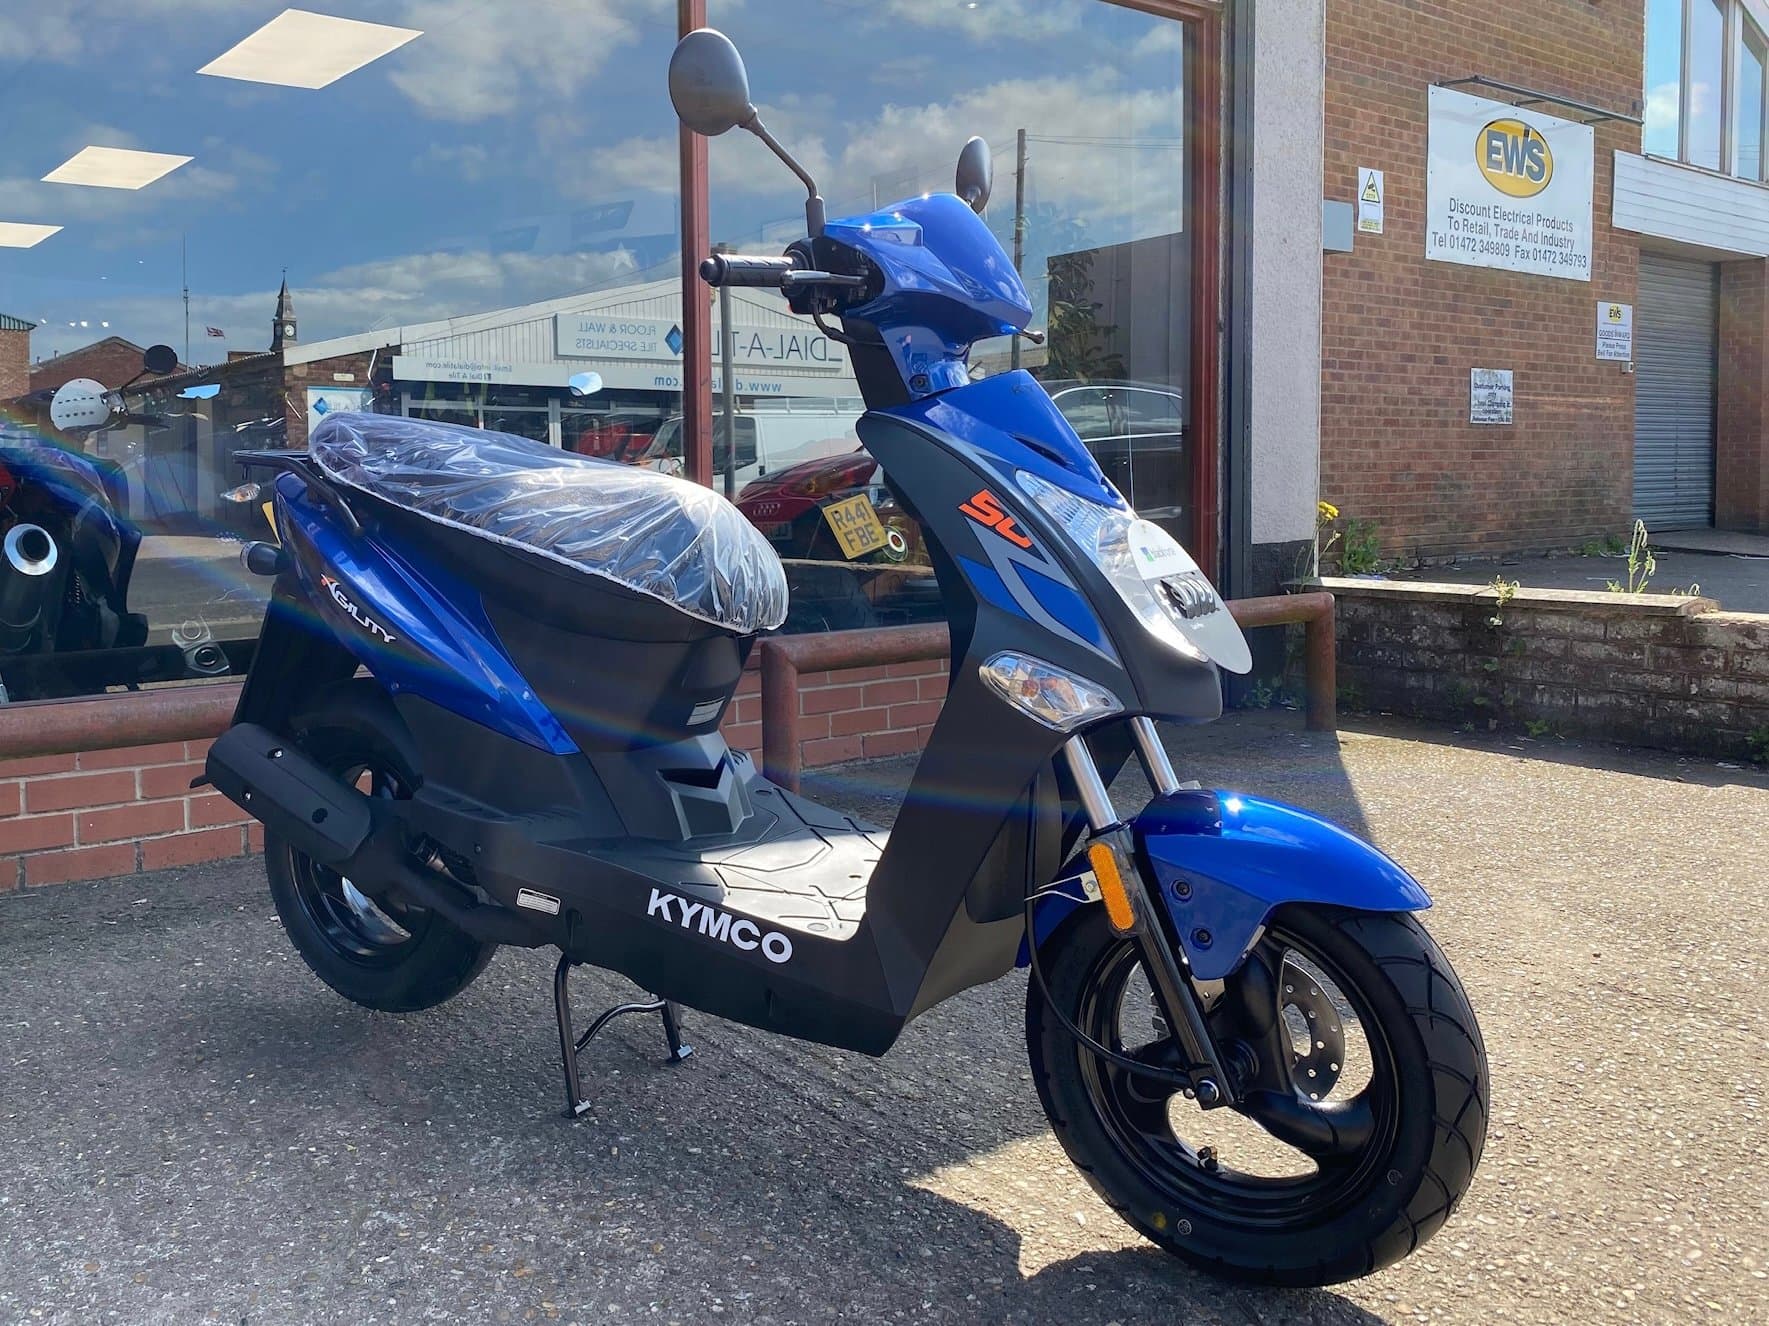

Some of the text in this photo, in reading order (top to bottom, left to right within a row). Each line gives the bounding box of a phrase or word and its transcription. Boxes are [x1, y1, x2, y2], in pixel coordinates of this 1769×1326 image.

[1449, 197, 1574, 233] Discount Electrical Products
[1432, 231, 1588, 269] Tel 01472 349809 Fax 01472 349793
[1447, 215, 1575, 253] To Retail, Trade And Industry
[831, 500, 871, 531] R441
[843, 522, 880, 551] FBE
[647, 887, 793, 964] KYMCO
